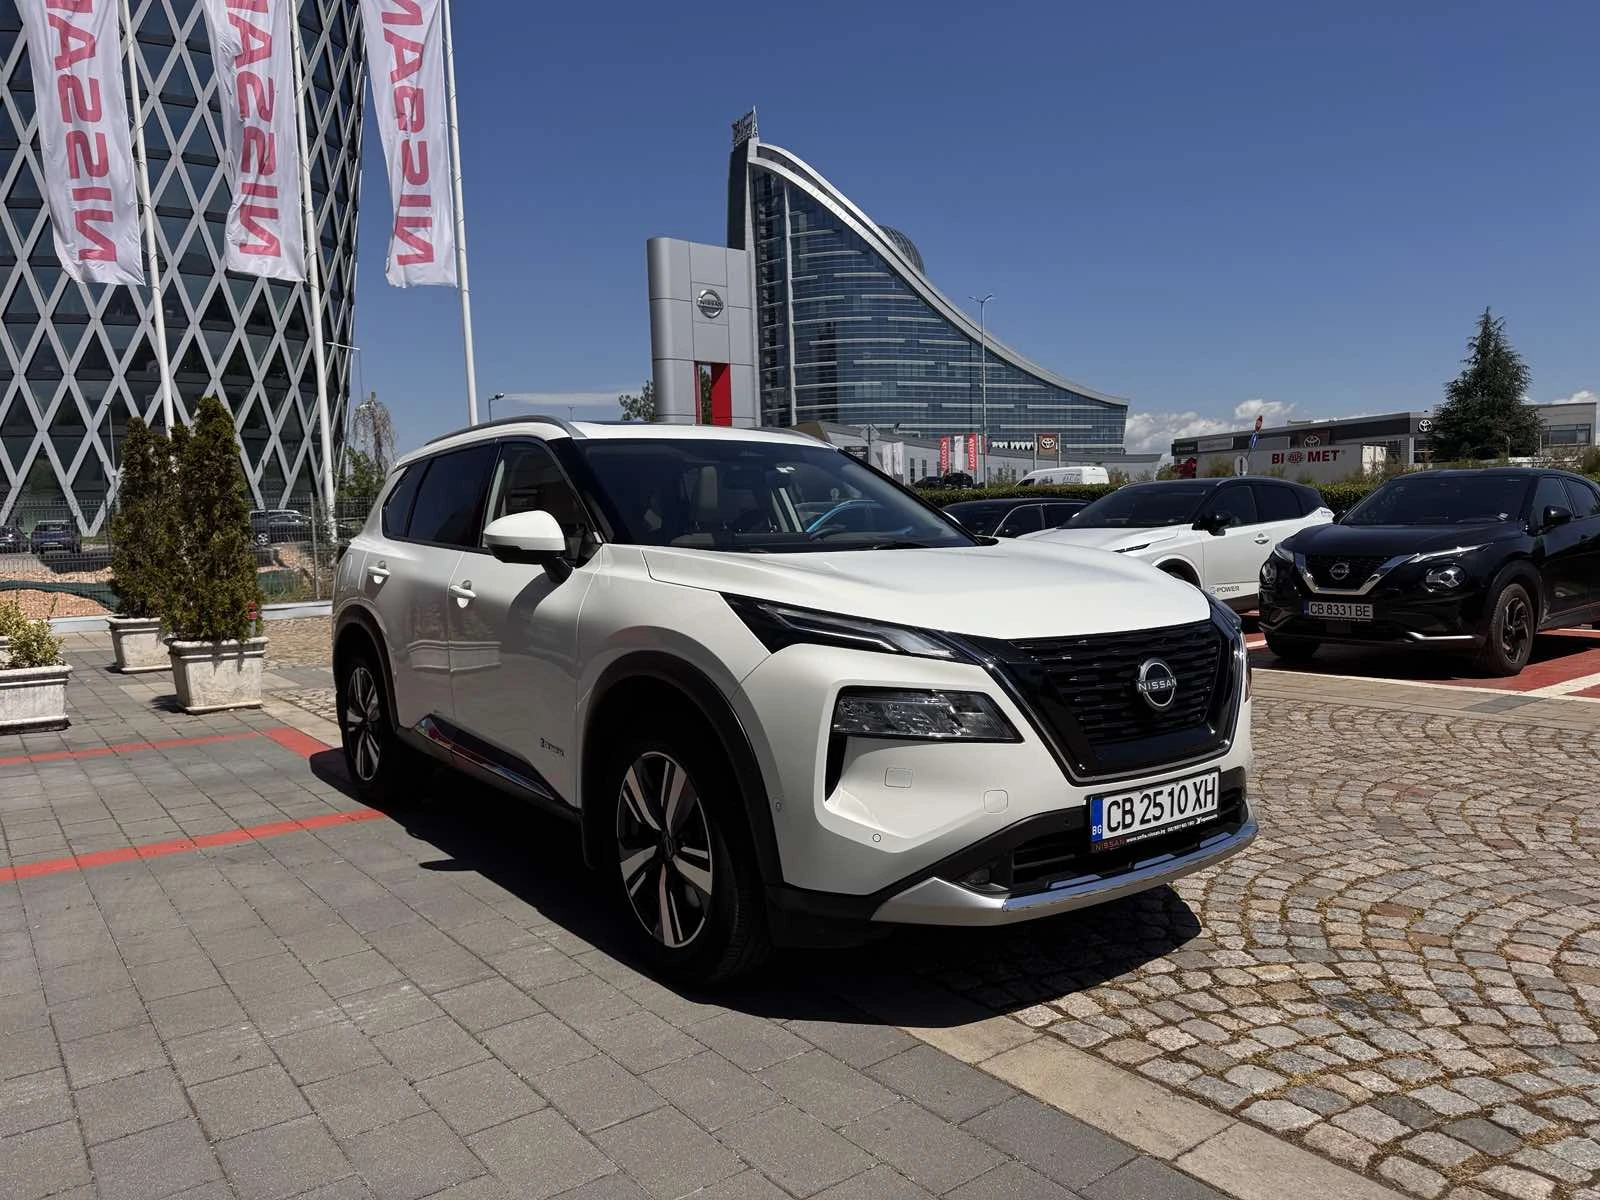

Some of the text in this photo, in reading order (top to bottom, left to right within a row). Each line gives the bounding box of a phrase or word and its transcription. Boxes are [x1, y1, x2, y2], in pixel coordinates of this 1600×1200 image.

[1310, 603, 1325, 615] CB
[1326, 604, 1352, 616] 8331
[1355, 605, 1371, 617] BE
[1138, 678, 1177, 691] NISSAN
[1106, 776, 1216, 833] CB 2510 XH
[1091, 824, 1103, 836] BG
